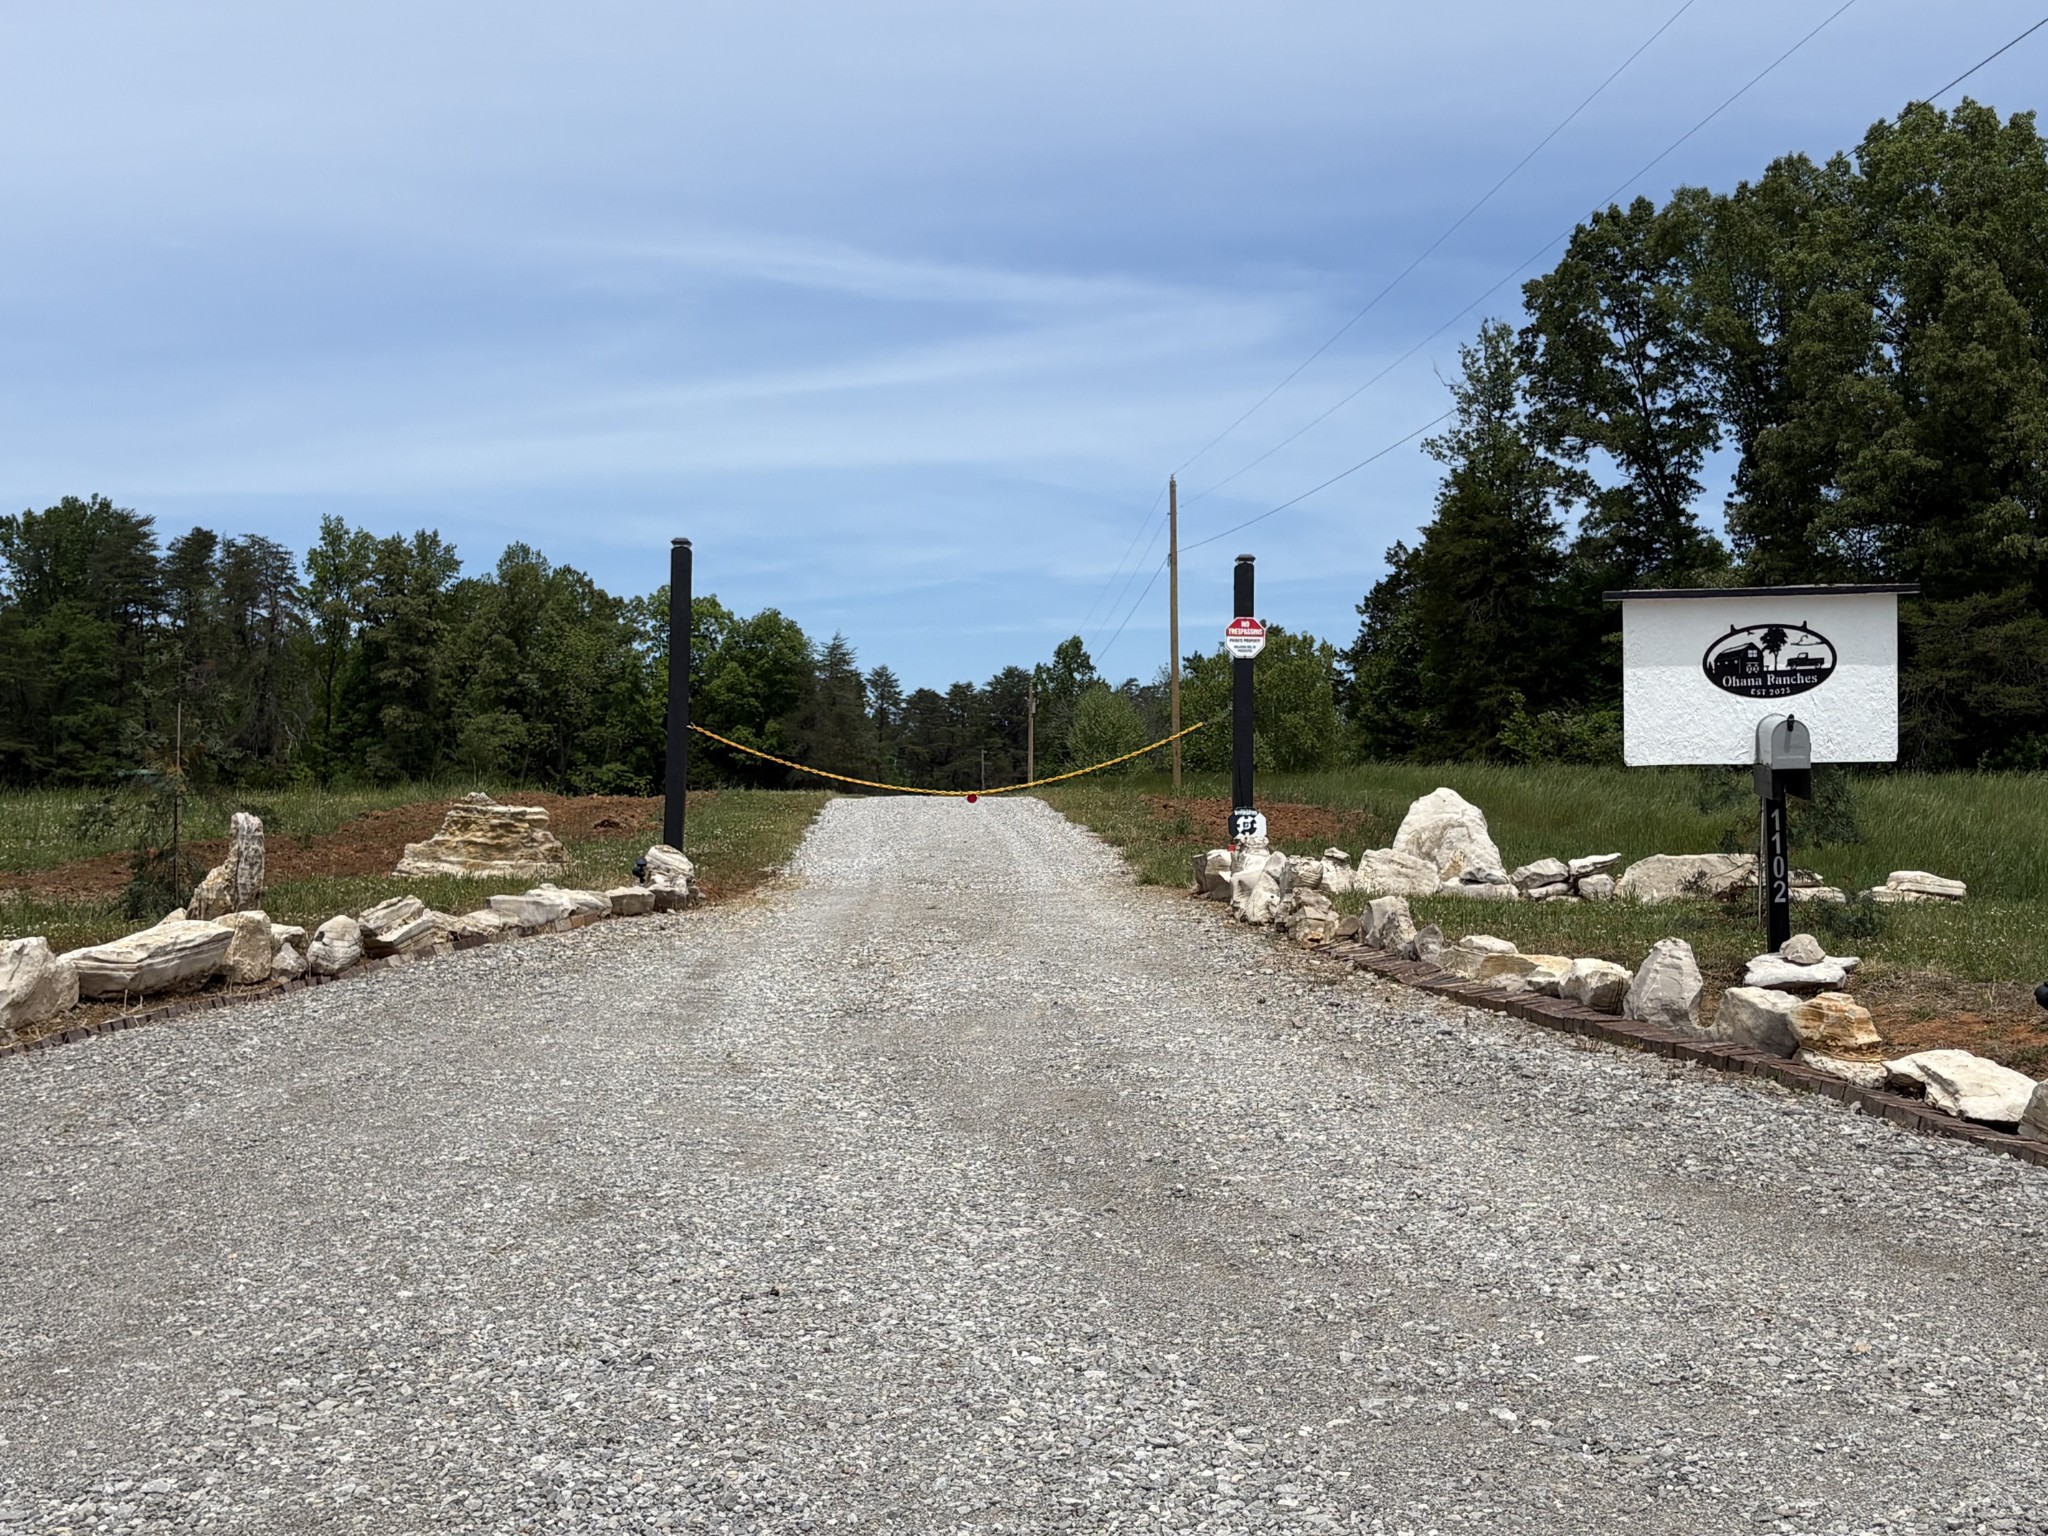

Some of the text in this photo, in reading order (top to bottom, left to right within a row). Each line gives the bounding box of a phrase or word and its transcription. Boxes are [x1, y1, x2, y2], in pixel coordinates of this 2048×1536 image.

[1722, 673, 1818, 687] Ohana Ranches
[1750, 687, 1791, 696] EST 2023
[1771, 808, 1787, 903] 1102
